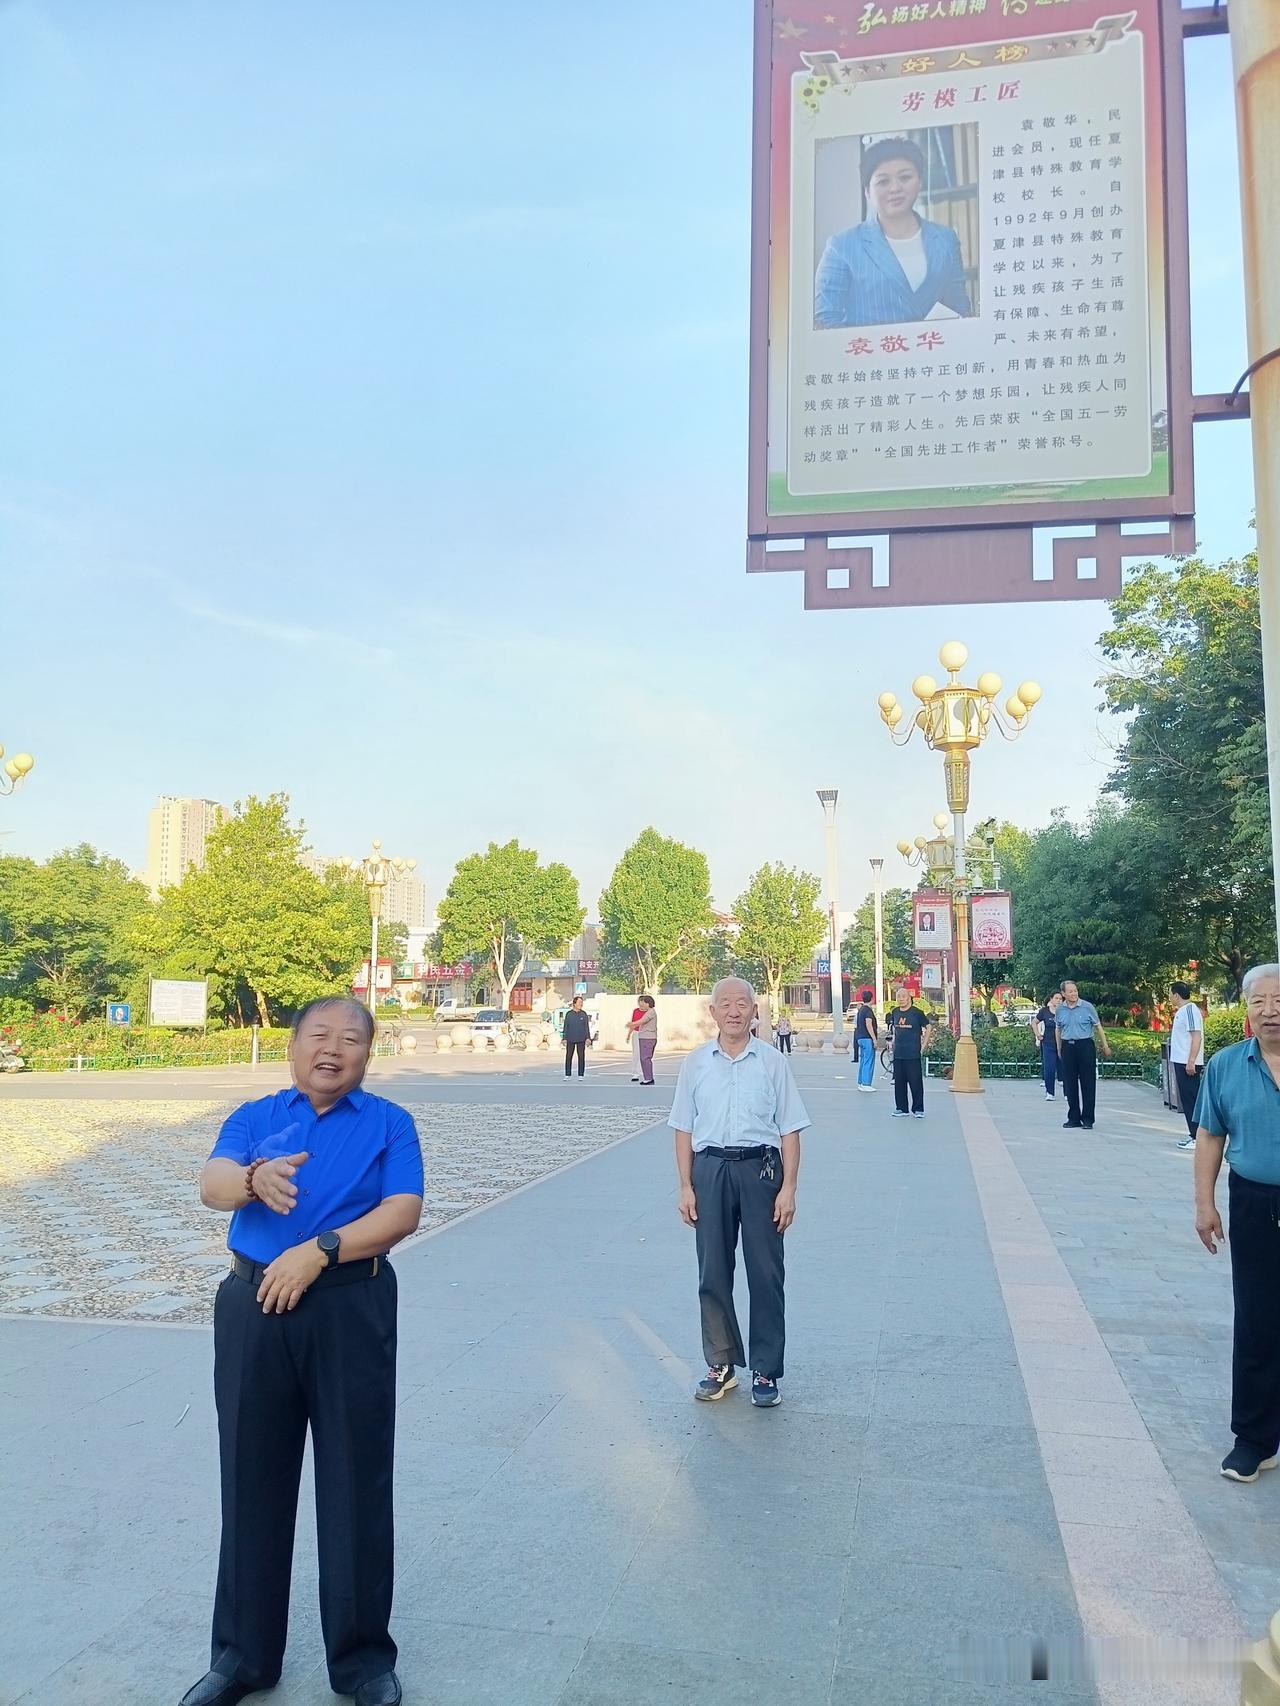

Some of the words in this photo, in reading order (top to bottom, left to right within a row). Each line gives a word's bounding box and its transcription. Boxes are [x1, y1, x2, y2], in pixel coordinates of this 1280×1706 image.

[902, 44, 1028, 73] 好人榜
[902, 80, 1020, 112] 劳模工匠
[1021, 109, 1121, 131] 袁敬华，民
[992, 132, 1122, 158] 进会员，现任夏
[992, 156, 1122, 180] 津县特殊教育学
[992, 180, 1121, 204] 校校长。自
[993, 204, 1123, 227] 1992年9月创办
[993, 228, 1123, 251] 夏津县特殊教育
[993, 251, 1123, 273] 学校以来，为了
[993, 275, 1124, 298] 让残疾孩子生活
[993, 299, 1124, 321] 有保障、生命有尊
[845, 332, 945, 355] 袁敬华
[993, 325, 1118, 345] 严、未来有希望，
[804, 351, 1126, 386] 袁敬华始终坚持守正创新，用青春和热血为
[803, 377, 1128, 411] 残疾孩子造就了一个梦想乐园，让残疾人同
[417, 963, 474, 976] 利民五金
